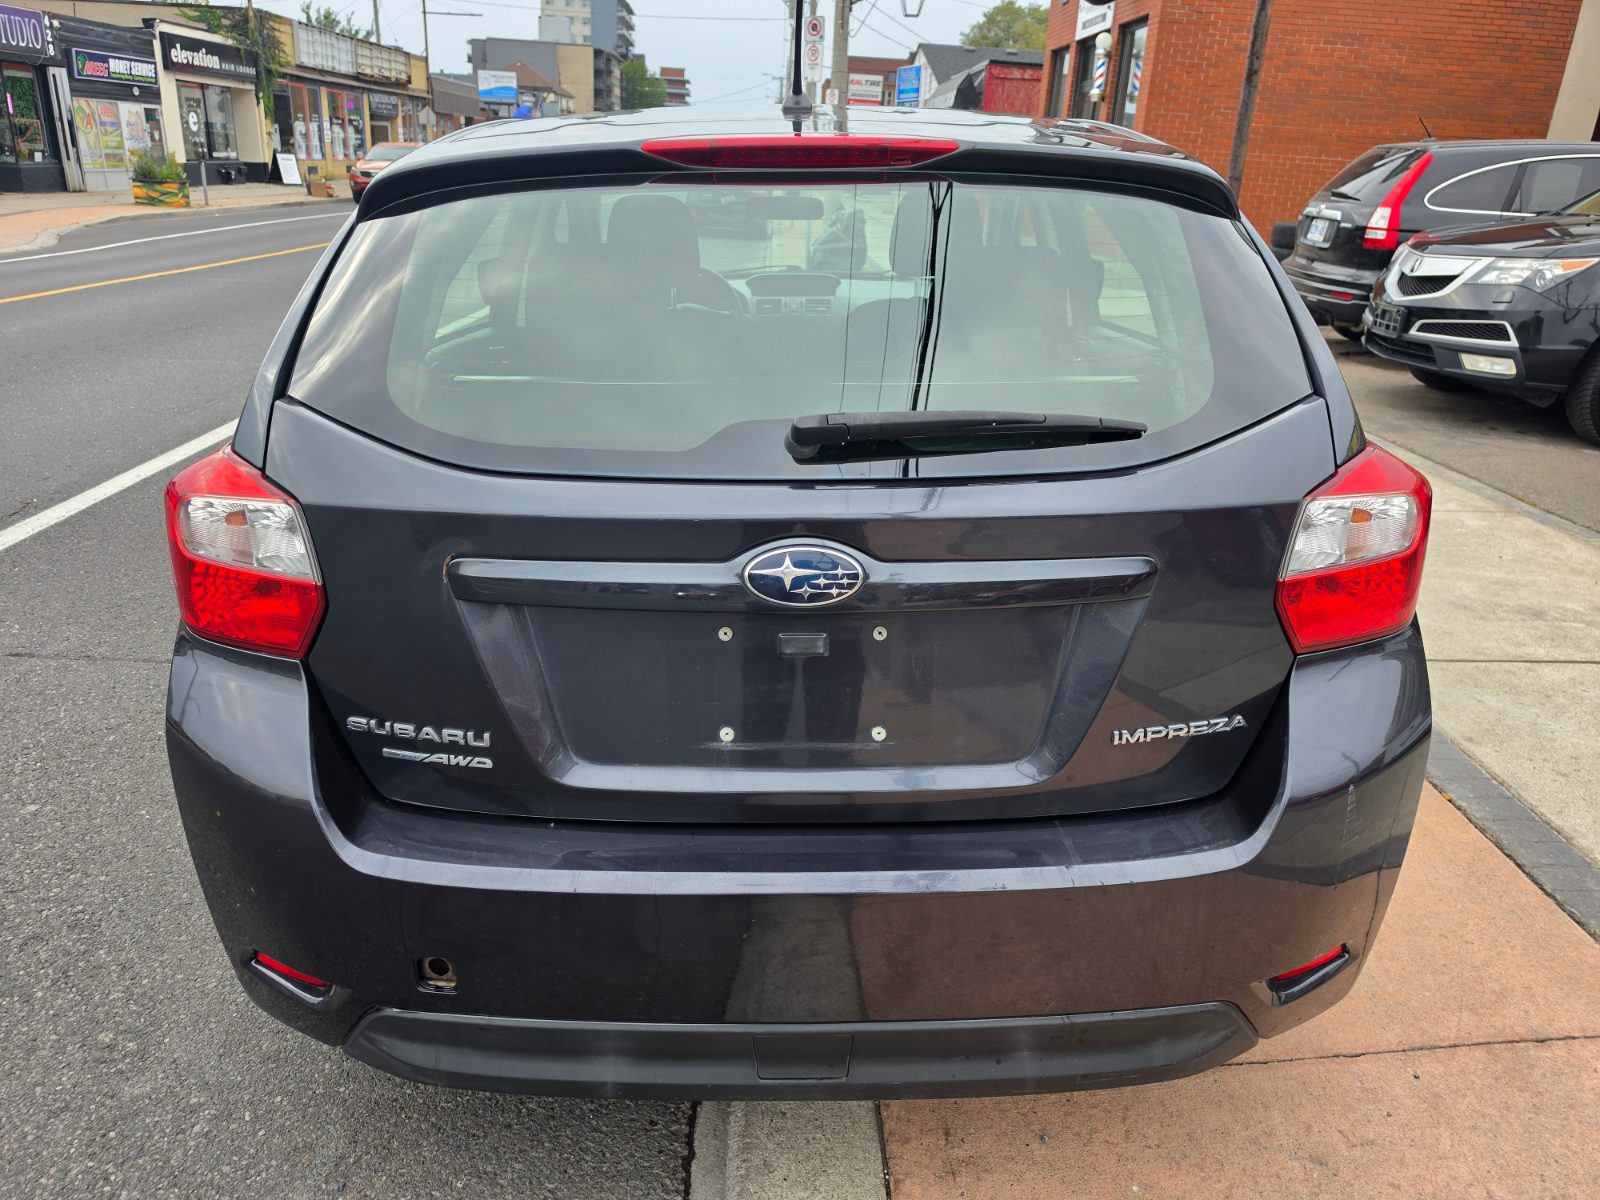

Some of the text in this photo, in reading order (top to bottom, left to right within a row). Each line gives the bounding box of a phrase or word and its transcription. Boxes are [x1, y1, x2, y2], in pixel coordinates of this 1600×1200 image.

[109, 58, 130, 75] MONEY
[130, 61, 156, 78] SERVICE
[170, 43, 220, 69] elevation
[346, 715, 491, 748] SUBARU
[1112, 714, 1248, 746] IMPREZA
[423, 753, 494, 769] AWD
